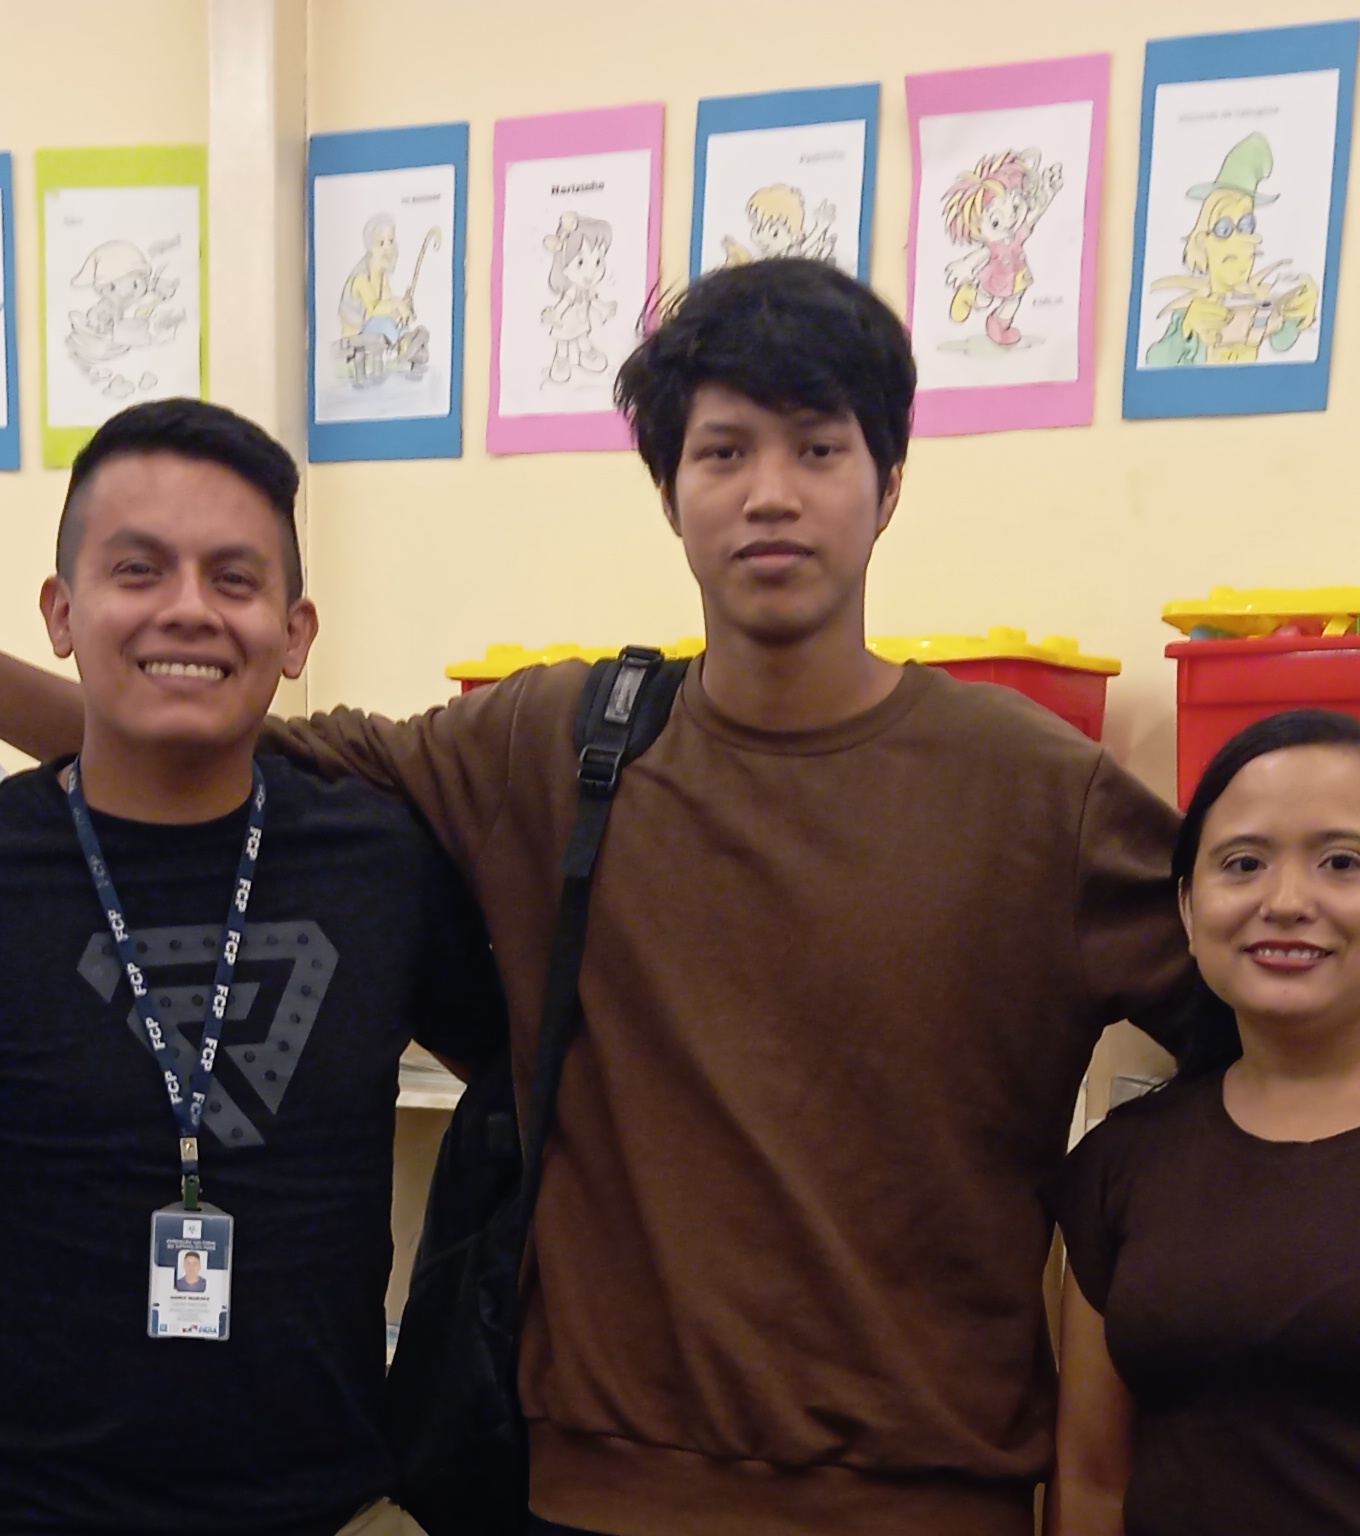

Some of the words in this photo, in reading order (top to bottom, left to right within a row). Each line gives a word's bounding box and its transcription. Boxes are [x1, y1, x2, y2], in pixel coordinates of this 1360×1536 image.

[246, 826, 262, 861] FCP
[235, 878, 252, 913] FCP
[108, 909, 129, 943] FCP
[224, 930, 241, 966] FCP
[127, 962, 147, 998] FCP
[212, 984, 229, 1020] FCP
[145, 1017, 166, 1051] FCP
[200, 1036, 218, 1072] FCP
[164, 1070, 183, 1105] FCP
